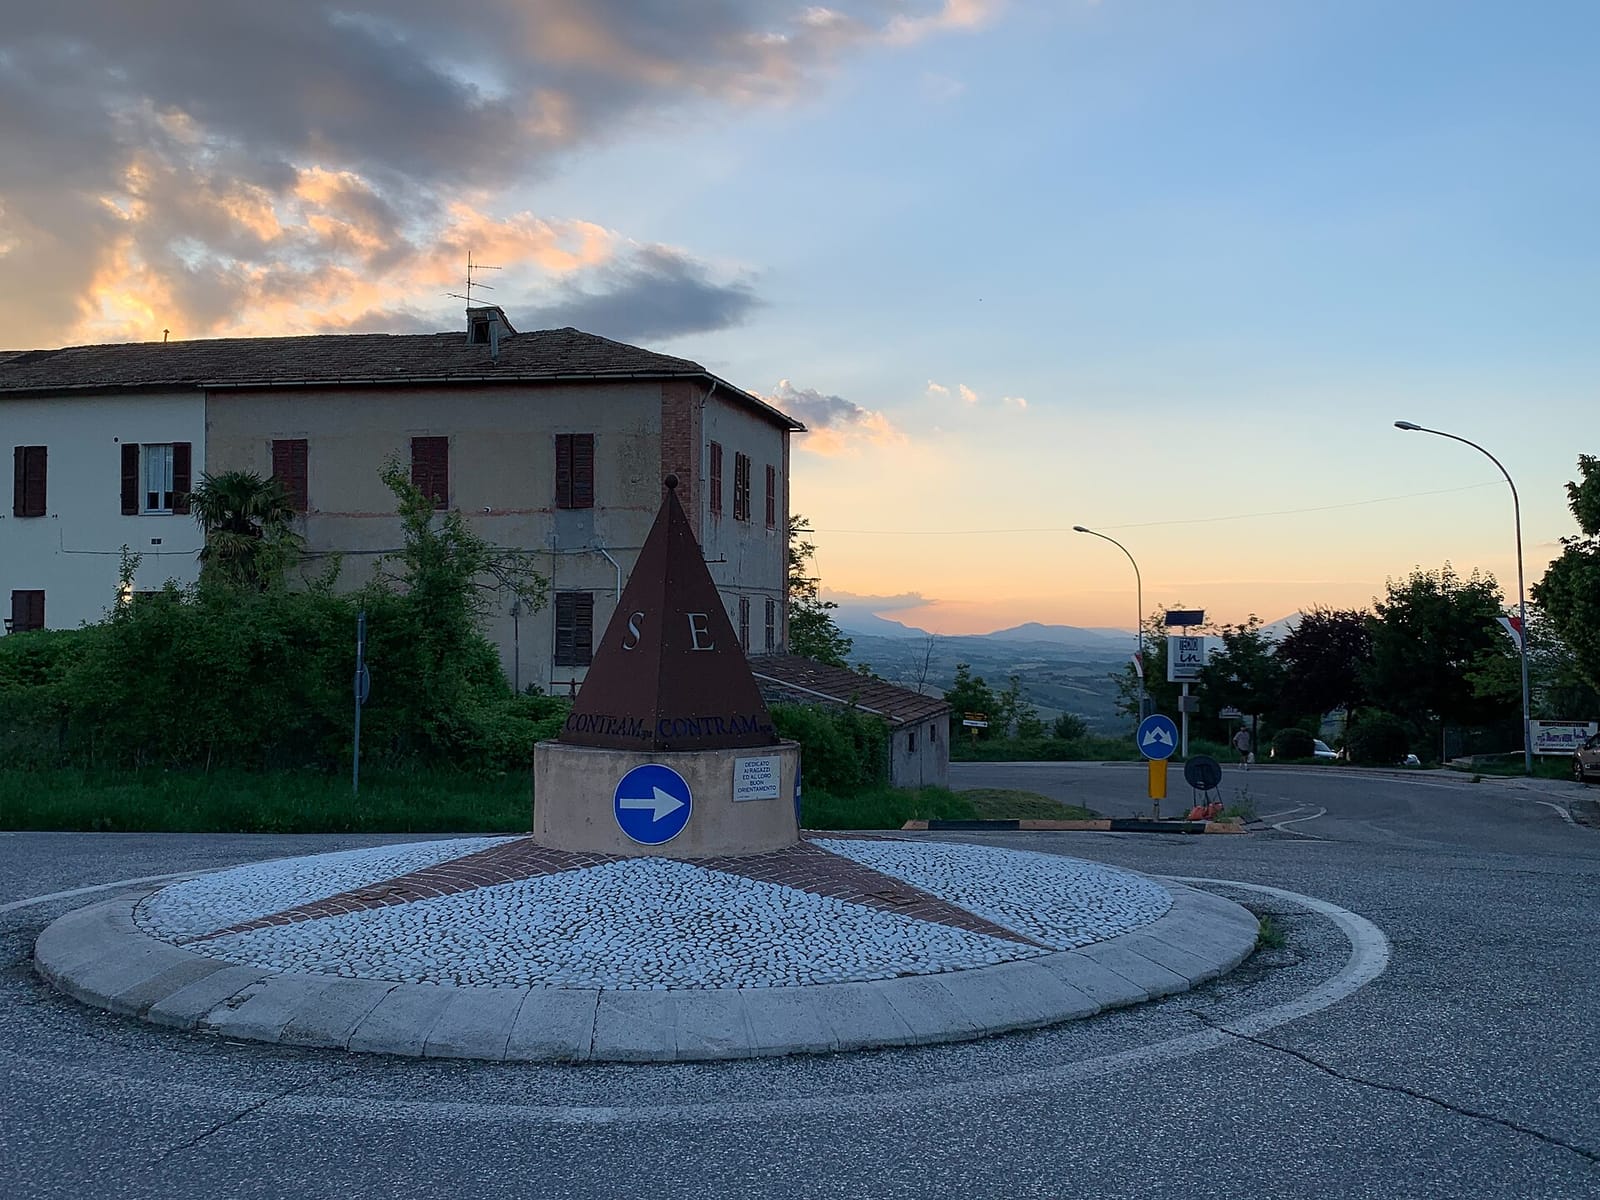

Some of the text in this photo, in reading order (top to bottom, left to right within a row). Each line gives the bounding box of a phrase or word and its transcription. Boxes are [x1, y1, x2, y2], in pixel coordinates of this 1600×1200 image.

[622, 611, 645, 650] S
[685, 612, 715, 651] E
[566, 713, 644, 737] CONTRAM
[658, 715, 758, 737] CONTRAM
[738, 785, 776, 793] ORIENTAMENTO
